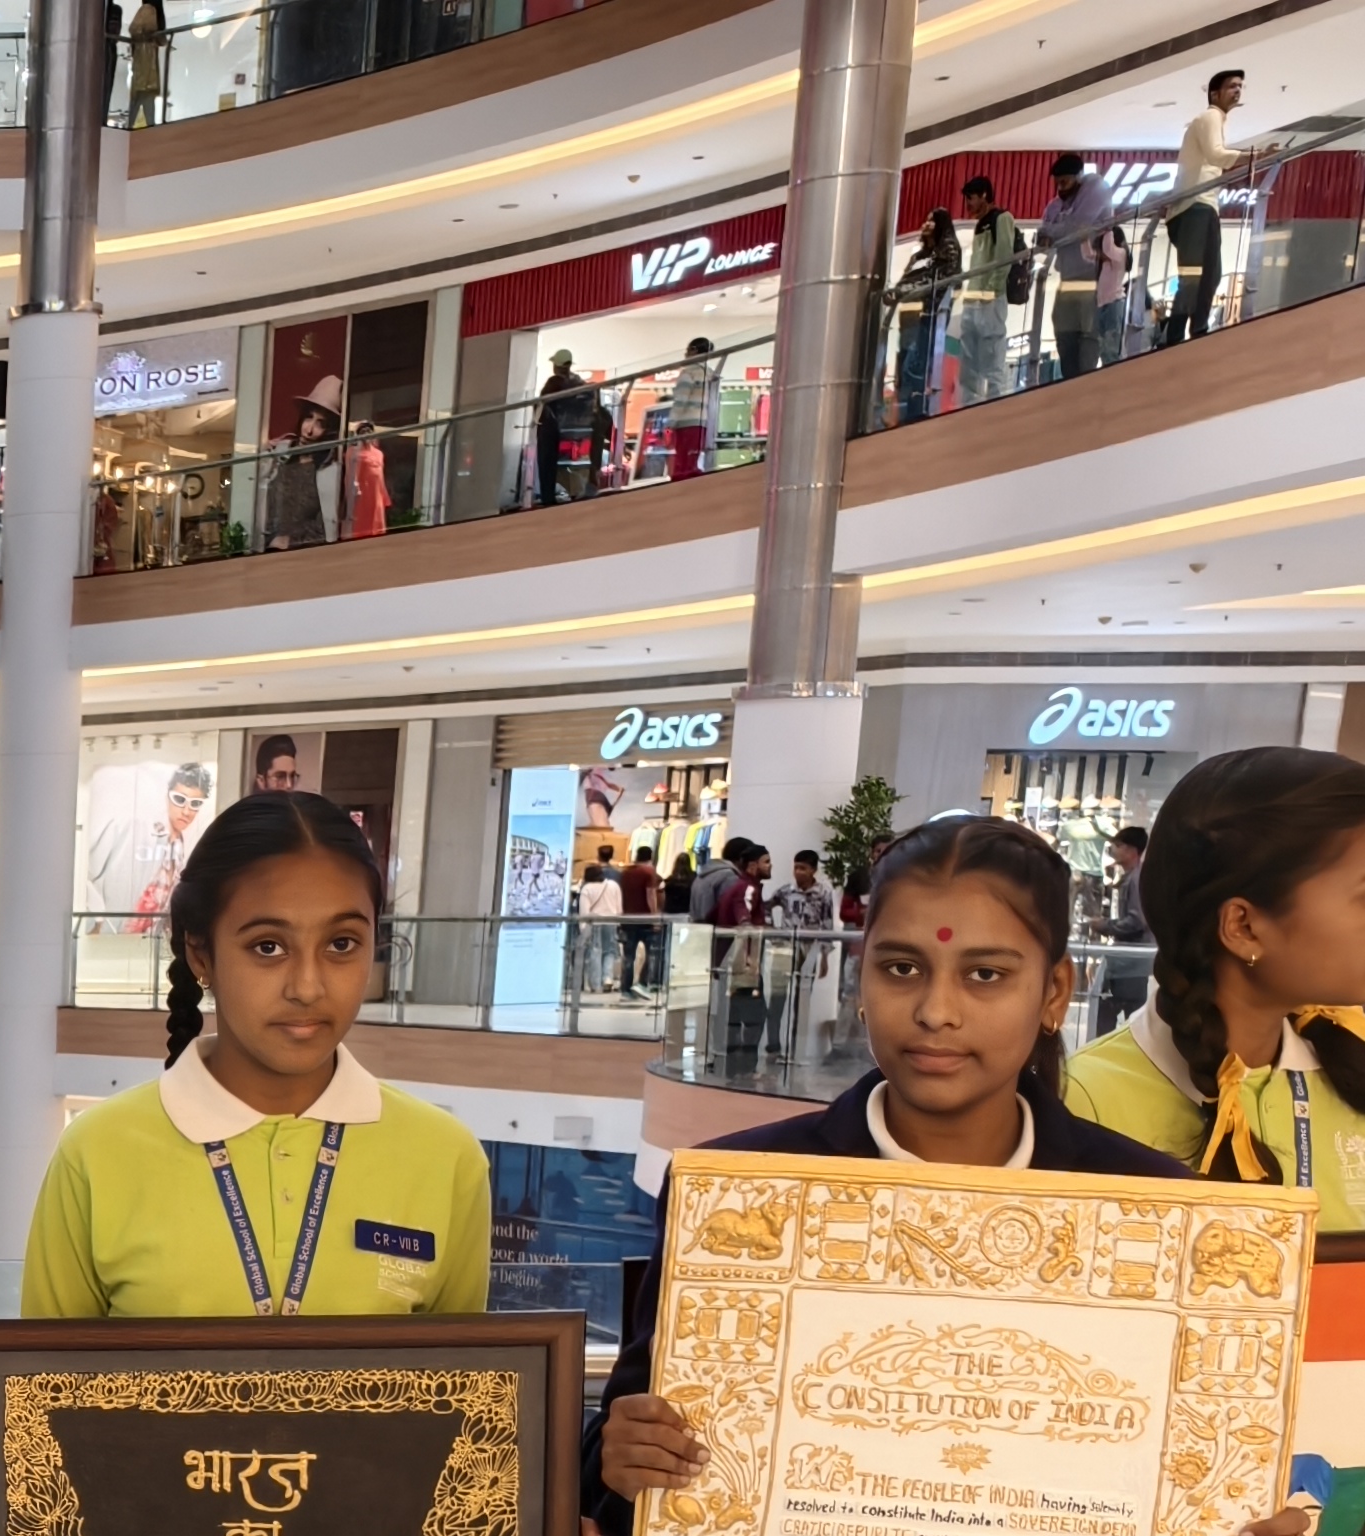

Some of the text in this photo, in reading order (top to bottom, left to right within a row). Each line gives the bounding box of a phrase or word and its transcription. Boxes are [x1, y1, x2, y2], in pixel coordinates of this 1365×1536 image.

[631, 237, 778, 291] VIP LOUNGE
[146, 360, 222, 388] ROSE
[290, 1168, 329, 1295] Global School of Excellence
[949, 1352, 1003, 1376] THE
[802, 1382, 1135, 1430] CONSTITUTION OF INDIA
[183, 1449, 317, 1512] भारत
[856, 1471, 899, 1498] THE
[989, 1483, 1035, 1508] INDIA
[1041, 1493, 1087, 1514] having
[786, 1498, 836, 1514] resolved
[841, 1502, 854, 1514] to
[861, 1502, 926, 1521] constitute
[931, 1508, 965, 1525] India
[968, 1512, 991, 1527] into
[997, 1517, 1004, 1528] a
[1009, 1512, 1098, 1534] SOVEREIGN
